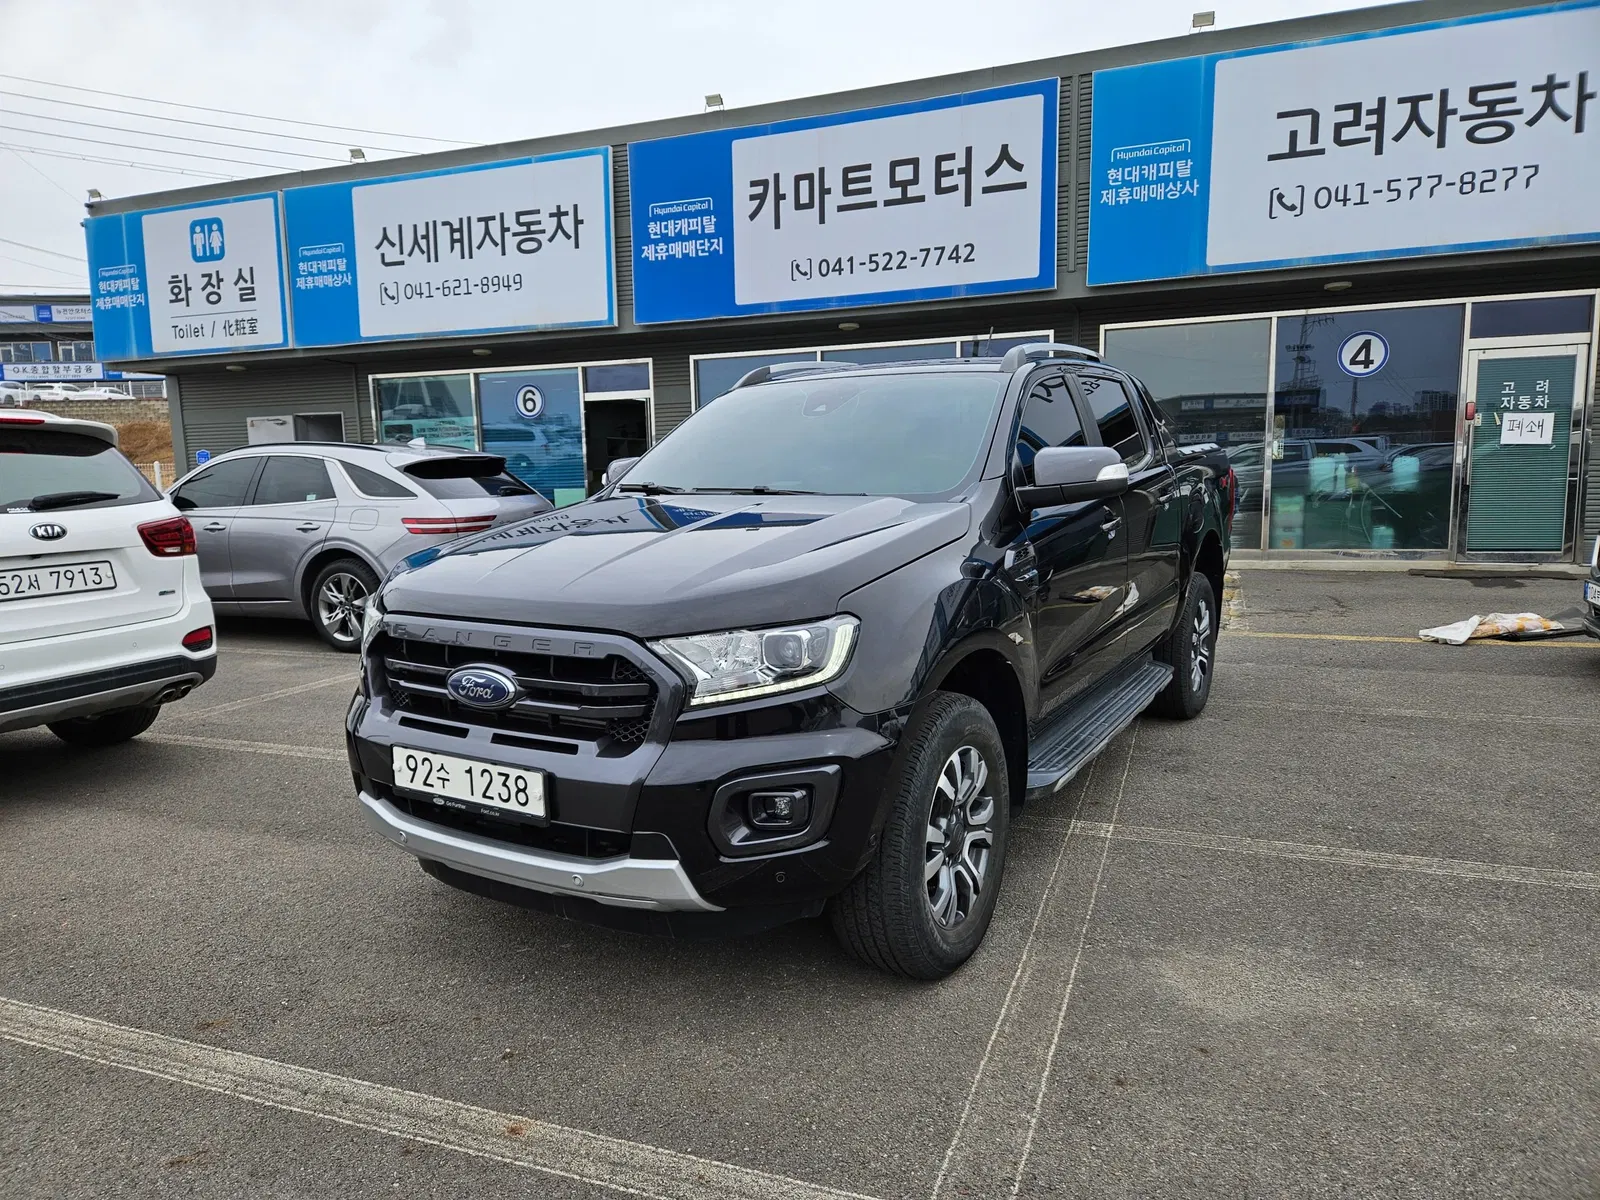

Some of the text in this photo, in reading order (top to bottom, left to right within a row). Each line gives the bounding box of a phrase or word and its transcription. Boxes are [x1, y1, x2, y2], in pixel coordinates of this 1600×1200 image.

[1267, 70, 1597, 163] 고려자동차
[1116, 143, 1185, 160] Hyundai Capital
[1107, 159, 1193, 186] 현대캐피탈
[748, 143, 1028, 230] 카마트모터스
[1100, 179, 1199, 206] 제휴매매상사
[1313, 163, 1541, 210] 041-577-8277
[653, 201, 709, 216] Hyundai Capital
[374, 203, 584, 267] 신세계자동차
[647, 215, 717, 239] 현대캐피탈
[641, 236, 723, 261] 제휴매매단지
[818, 243, 976, 278] 041-522-7742
[298, 257, 347, 275] 현대캐피탈
[98, 277, 139, 294] 현대캐피탈
[296, 272, 352, 290] 제휴매매상사
[404, 273, 523, 300] 041-621-8949
[95, 293, 145, 310] 제휴매매단지
[171, 323, 205, 339] Toilet
[1349, 338, 1376, 370] 4
[522, 388, 537, 413] 6
[1500, 395, 1550, 410] 자동차
[35, 526, 63, 537] KIA
[49, 567, 103, 590] 7913
[390, 621, 596, 656] RANGER
[458, 675, 494, 699] Ford
[405, 754, 529, 807] 92수 1238
